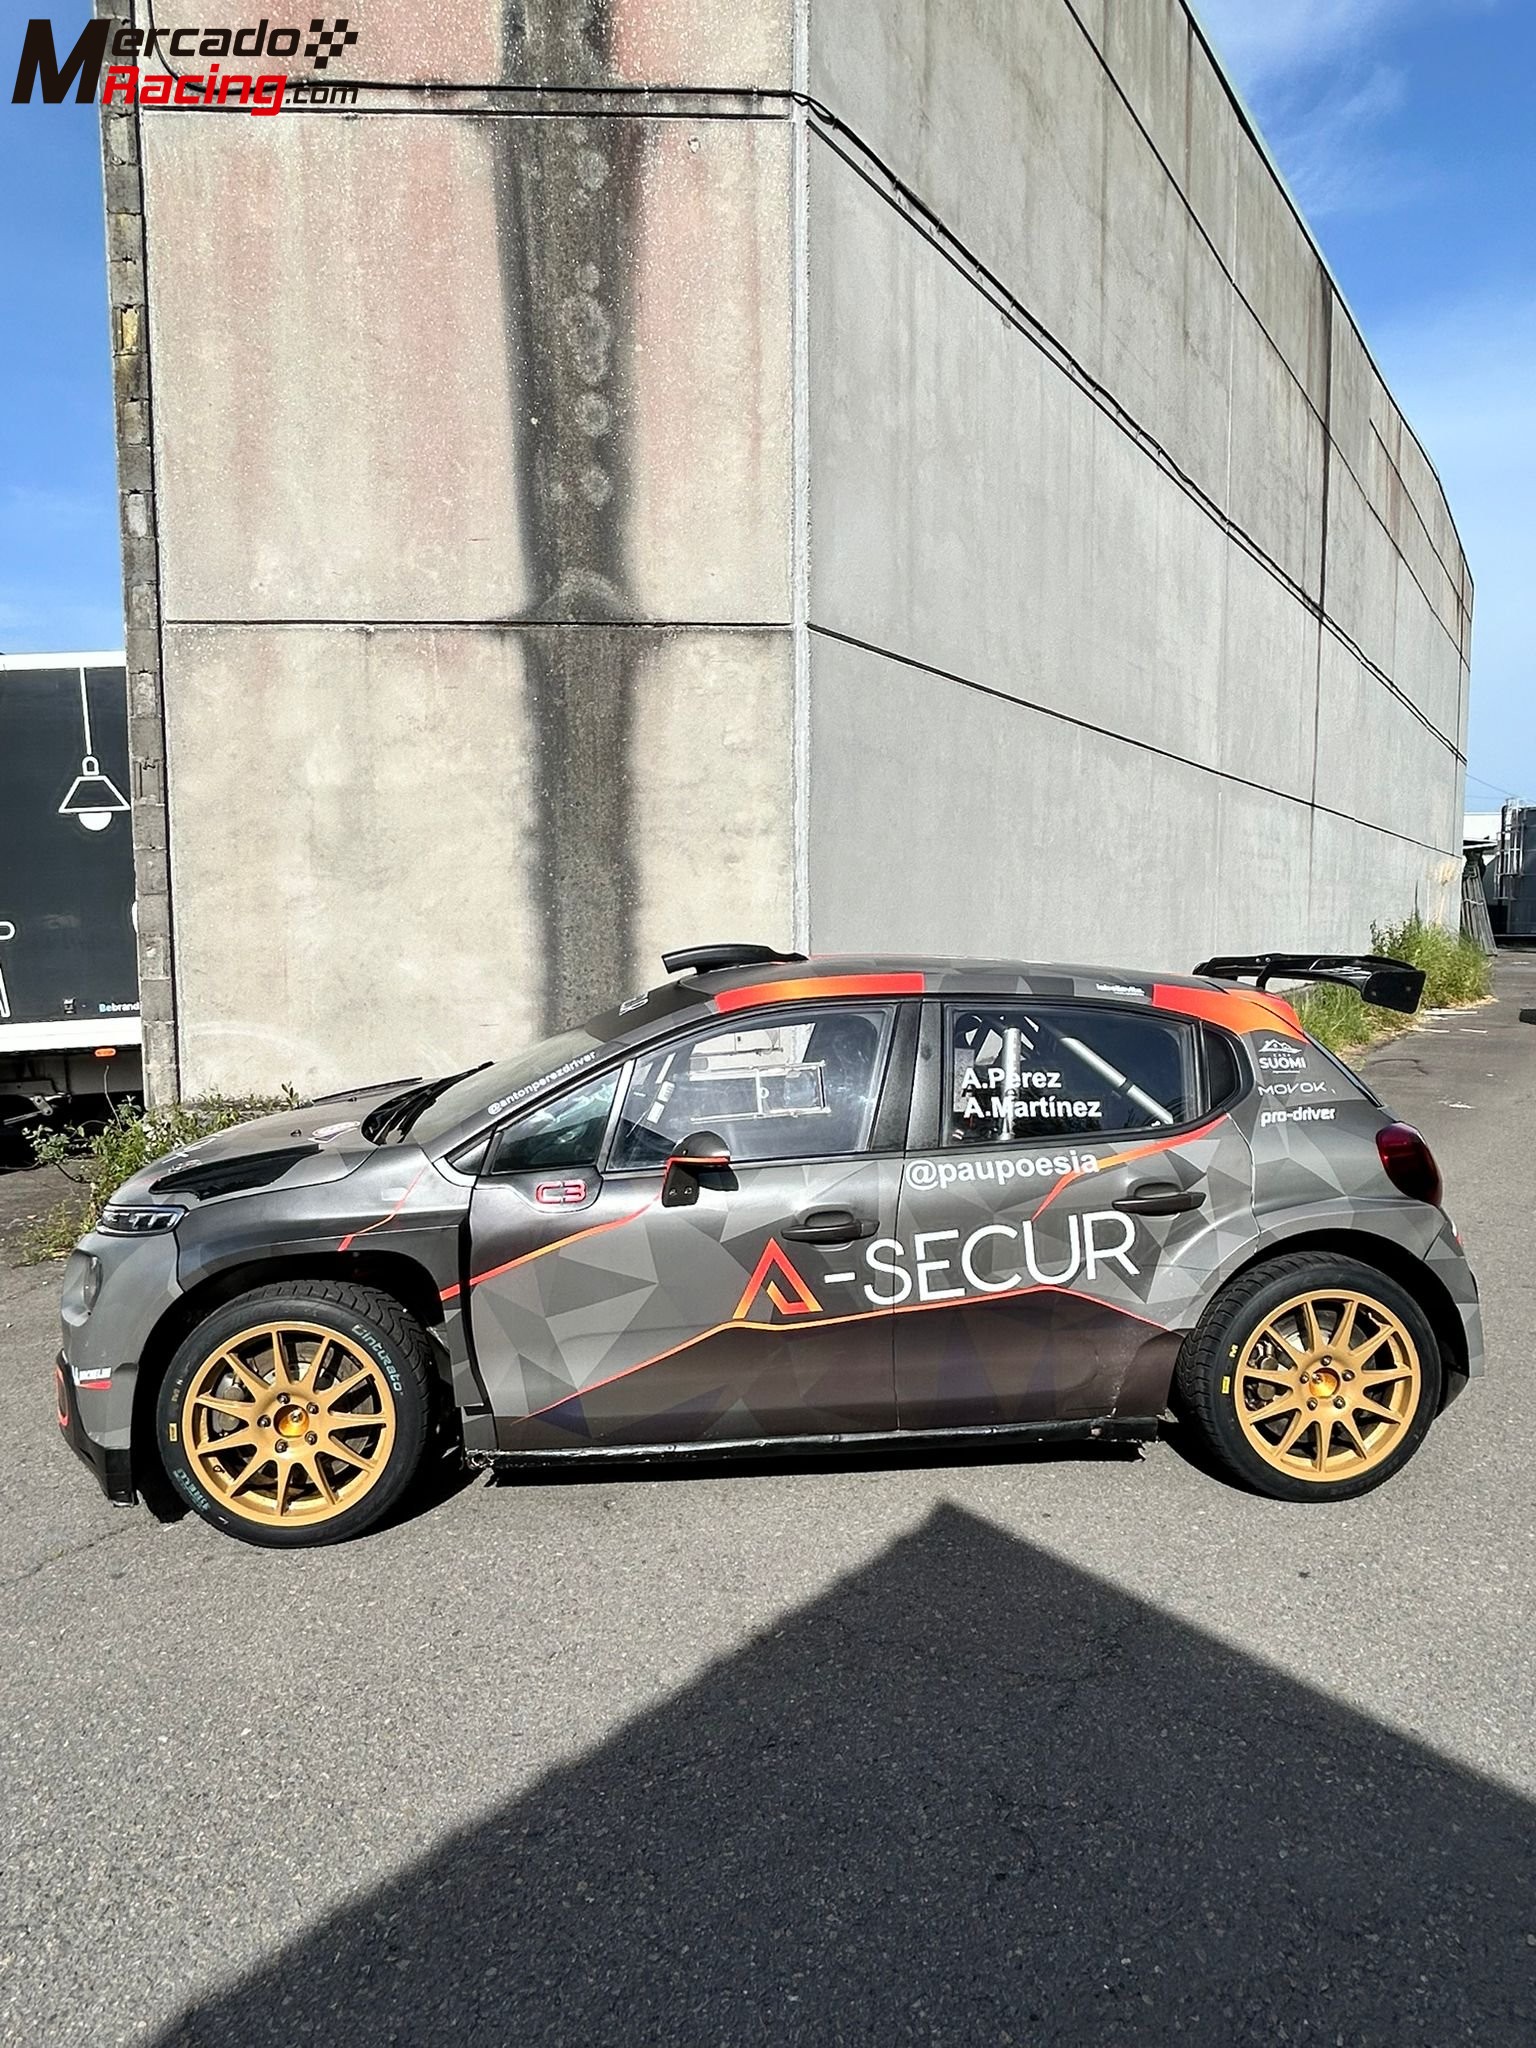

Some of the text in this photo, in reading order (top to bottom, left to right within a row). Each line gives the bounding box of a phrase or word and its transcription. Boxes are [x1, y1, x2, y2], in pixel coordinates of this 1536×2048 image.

[1259, 1056, 1307, 1069] SUOMI
[488, 1051, 596, 1115] @antonperezdriver
[1258, 1082, 1327, 1096] MOVOK
[964, 1096, 1102, 1119] A.Martínez
[1261, 1107, 1336, 1127] pro-driver
[905, 1150, 1100, 1191] @paupoesia
[536, 1180, 586, 1204] C3
